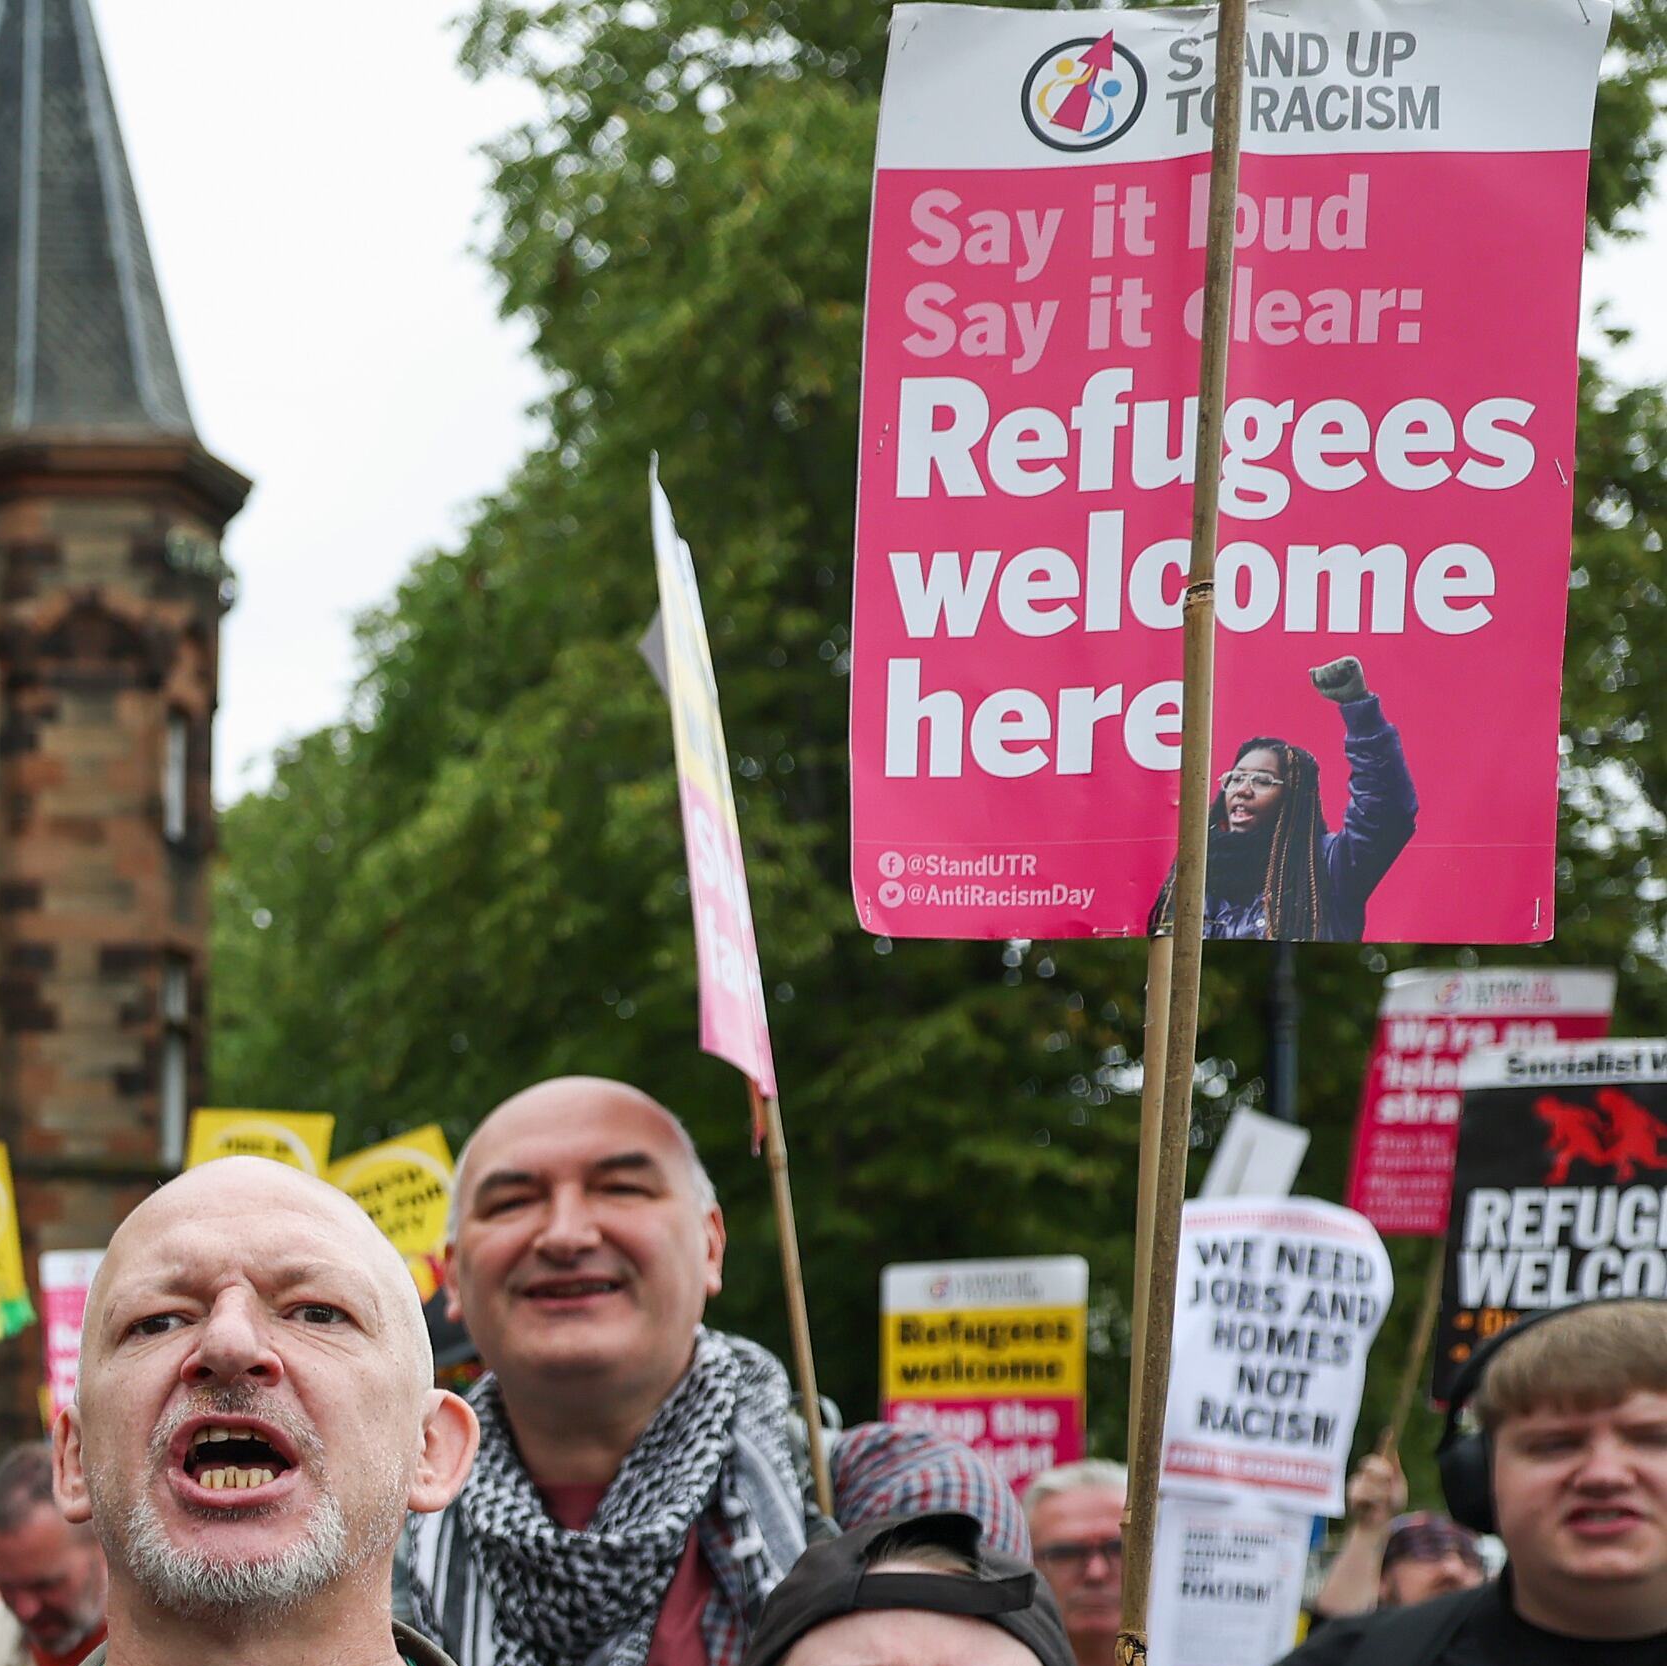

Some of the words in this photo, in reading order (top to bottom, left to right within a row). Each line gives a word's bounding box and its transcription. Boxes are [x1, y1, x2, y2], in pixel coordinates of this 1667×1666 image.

[1346, 31, 1417, 77] UP
[1250, 84, 1440, 132] RACISM
[907, 189, 1064, 283] Say
[1092, 184, 1156, 258] it
[902, 281, 1060, 374] Say
[1088, 275, 1152, 349] it
[895, 367, 1535, 521] Refugees
[888, 511, 1495, 638] welcome
[885, 658, 1183, 778] here
[907, 854, 1037, 877] @StandUTR
[907, 884, 1095, 910] @AntiRacismDay
[1464, 1184, 1667, 1250] REFUG
[1197, 1240, 1257, 1270] WE
[1277, 1244, 1374, 1283] NEED
[1457, 1246, 1667, 1310] WELCO
[1189, 1279, 1284, 1313] JOBS
[1301, 1290, 1377, 1328] AND
[900, 1315, 1072, 1351] Refugees
[1214, 1322, 1352, 1365] HOMES
[900, 1357, 1063, 1383] welcome
[1237, 1366, 1311, 1399] NOT
[990, 1401, 1060, 1439] the
[1198, 1400, 1339, 1448] RACISM
